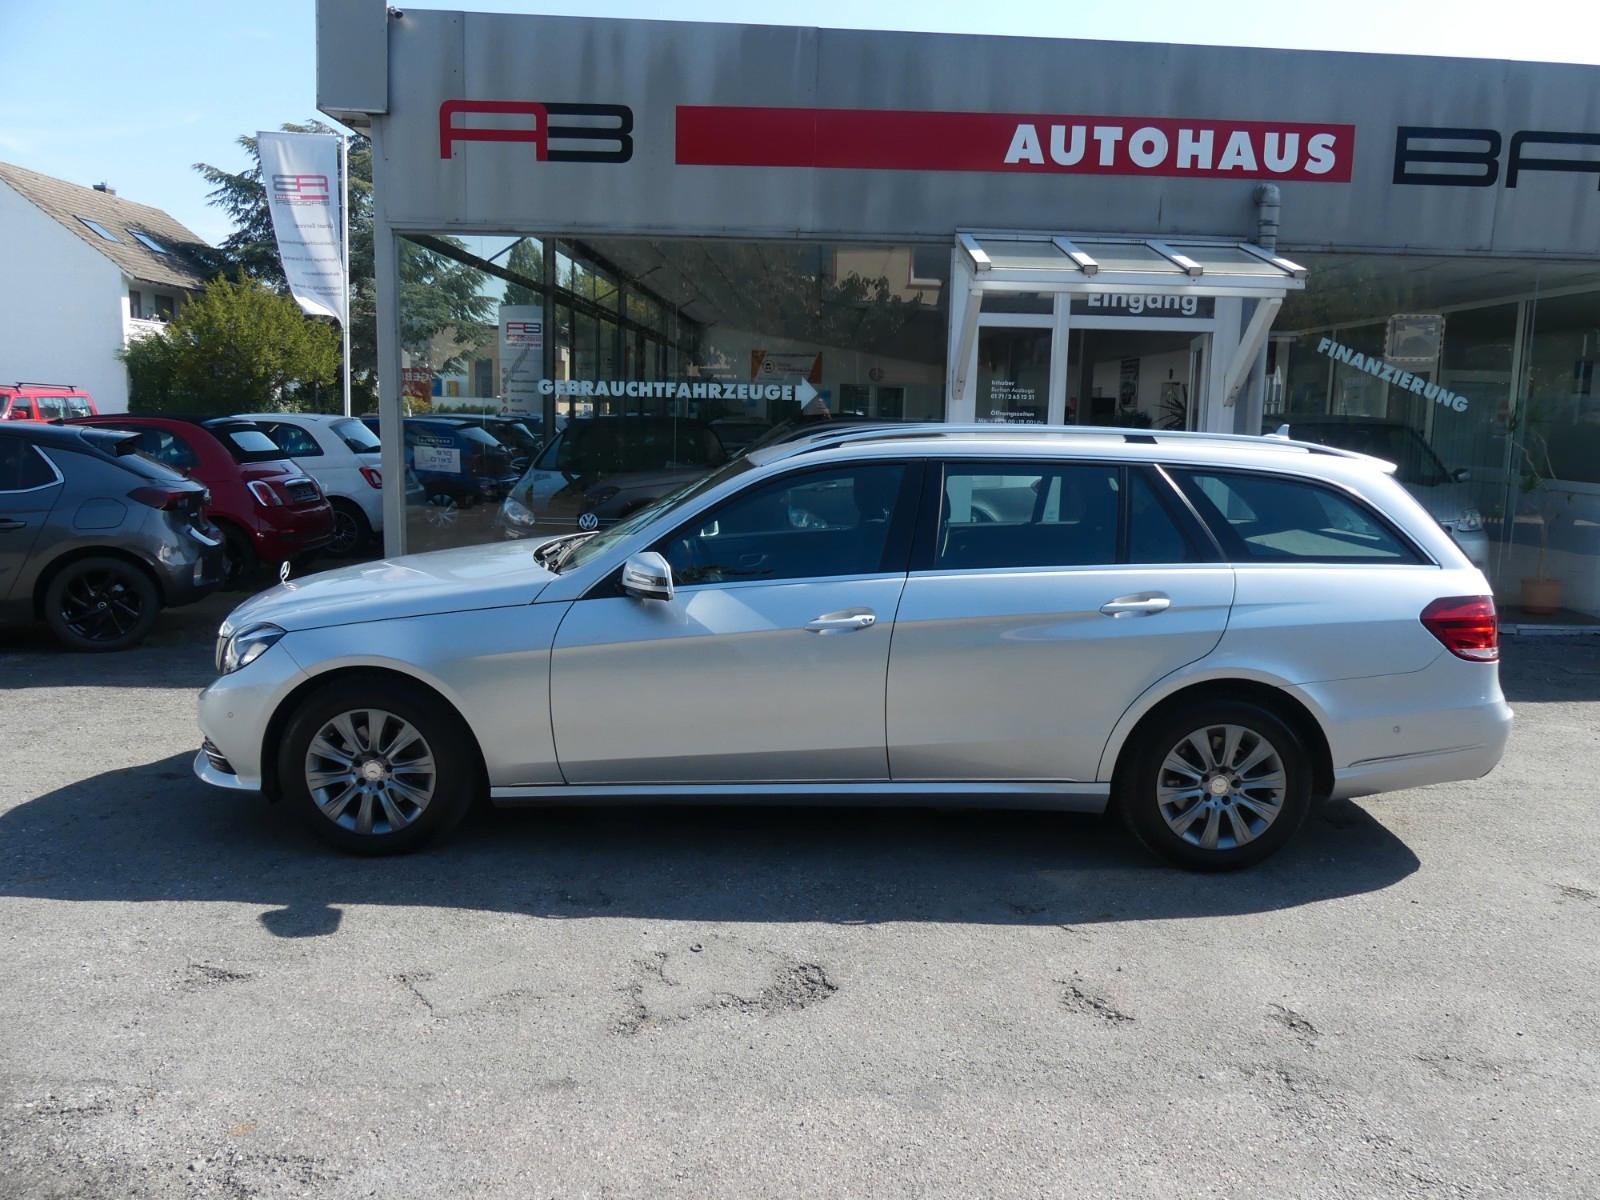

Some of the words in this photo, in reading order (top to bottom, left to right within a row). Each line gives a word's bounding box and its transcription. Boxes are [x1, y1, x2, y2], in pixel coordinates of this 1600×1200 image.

[439, 99, 634, 163] AB
[1003, 124, 1337, 175] AUTOHAUS
[1087, 292, 1198, 316] Eingang
[537, 379, 793, 401] GEBRAUCHTFAHRZEUGE
[1316, 336, 1470, 413] FINANZIERUNG
